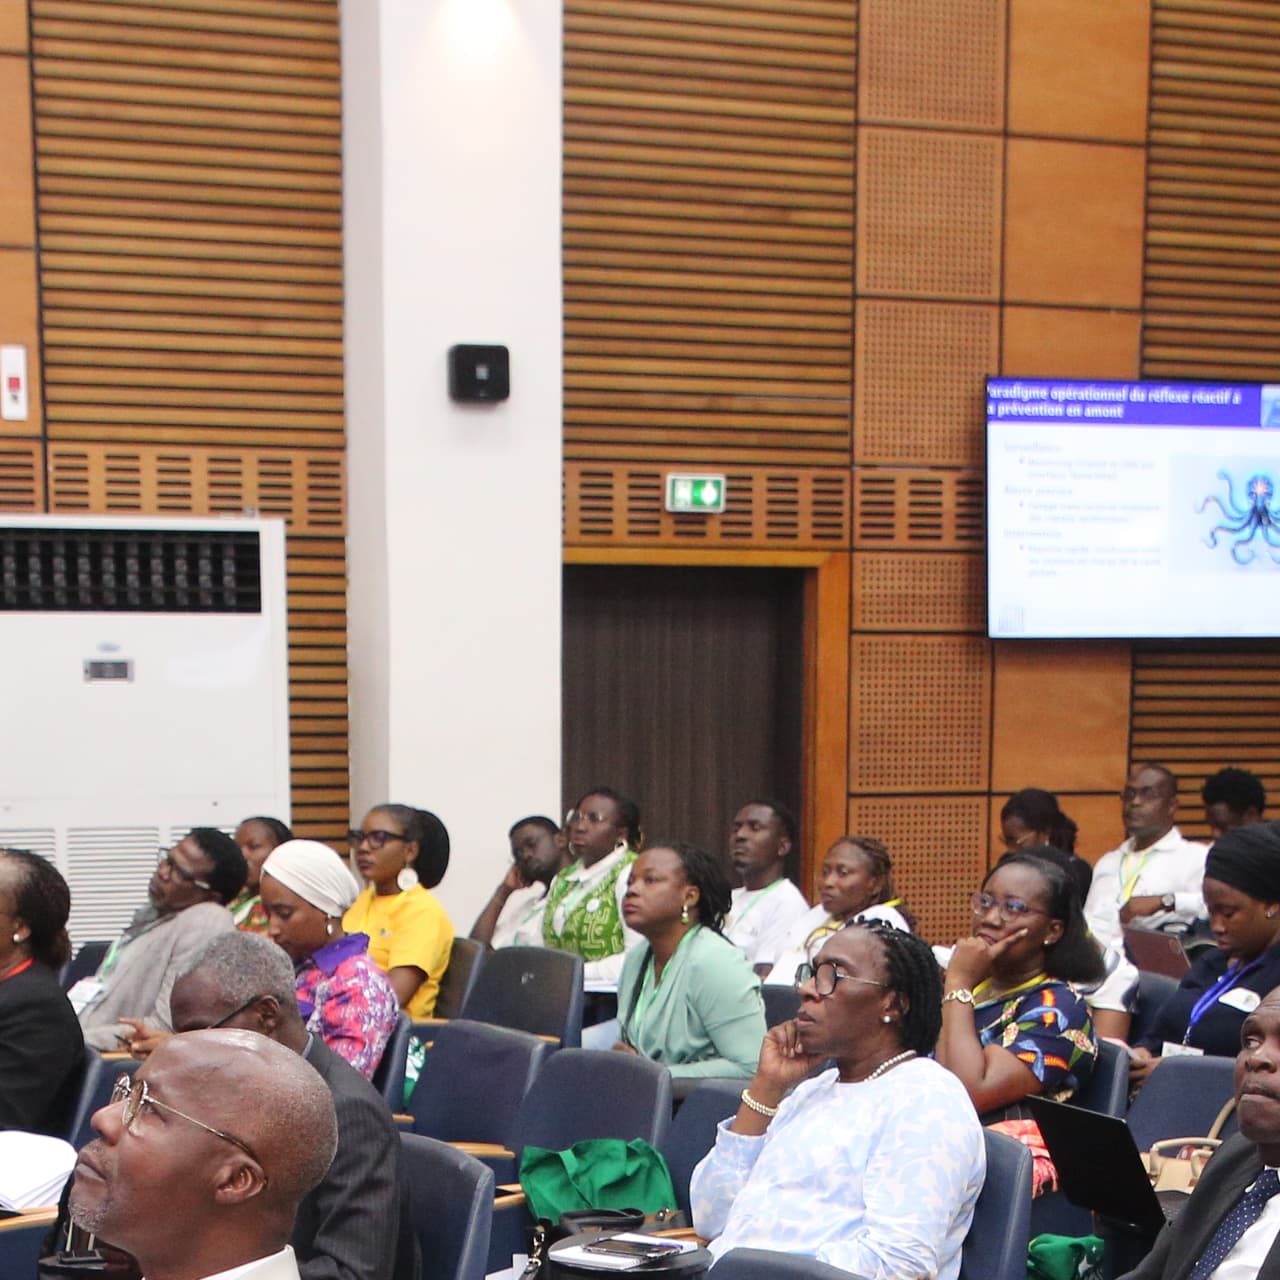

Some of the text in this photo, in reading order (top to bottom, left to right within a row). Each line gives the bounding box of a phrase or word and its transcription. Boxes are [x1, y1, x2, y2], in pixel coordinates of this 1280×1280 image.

[1129, 386, 1145, 402] du
[997, 402, 1064, 418] prévention
[1066, 405, 1081, 417] en
[1084, 406, 1124, 418] amont
